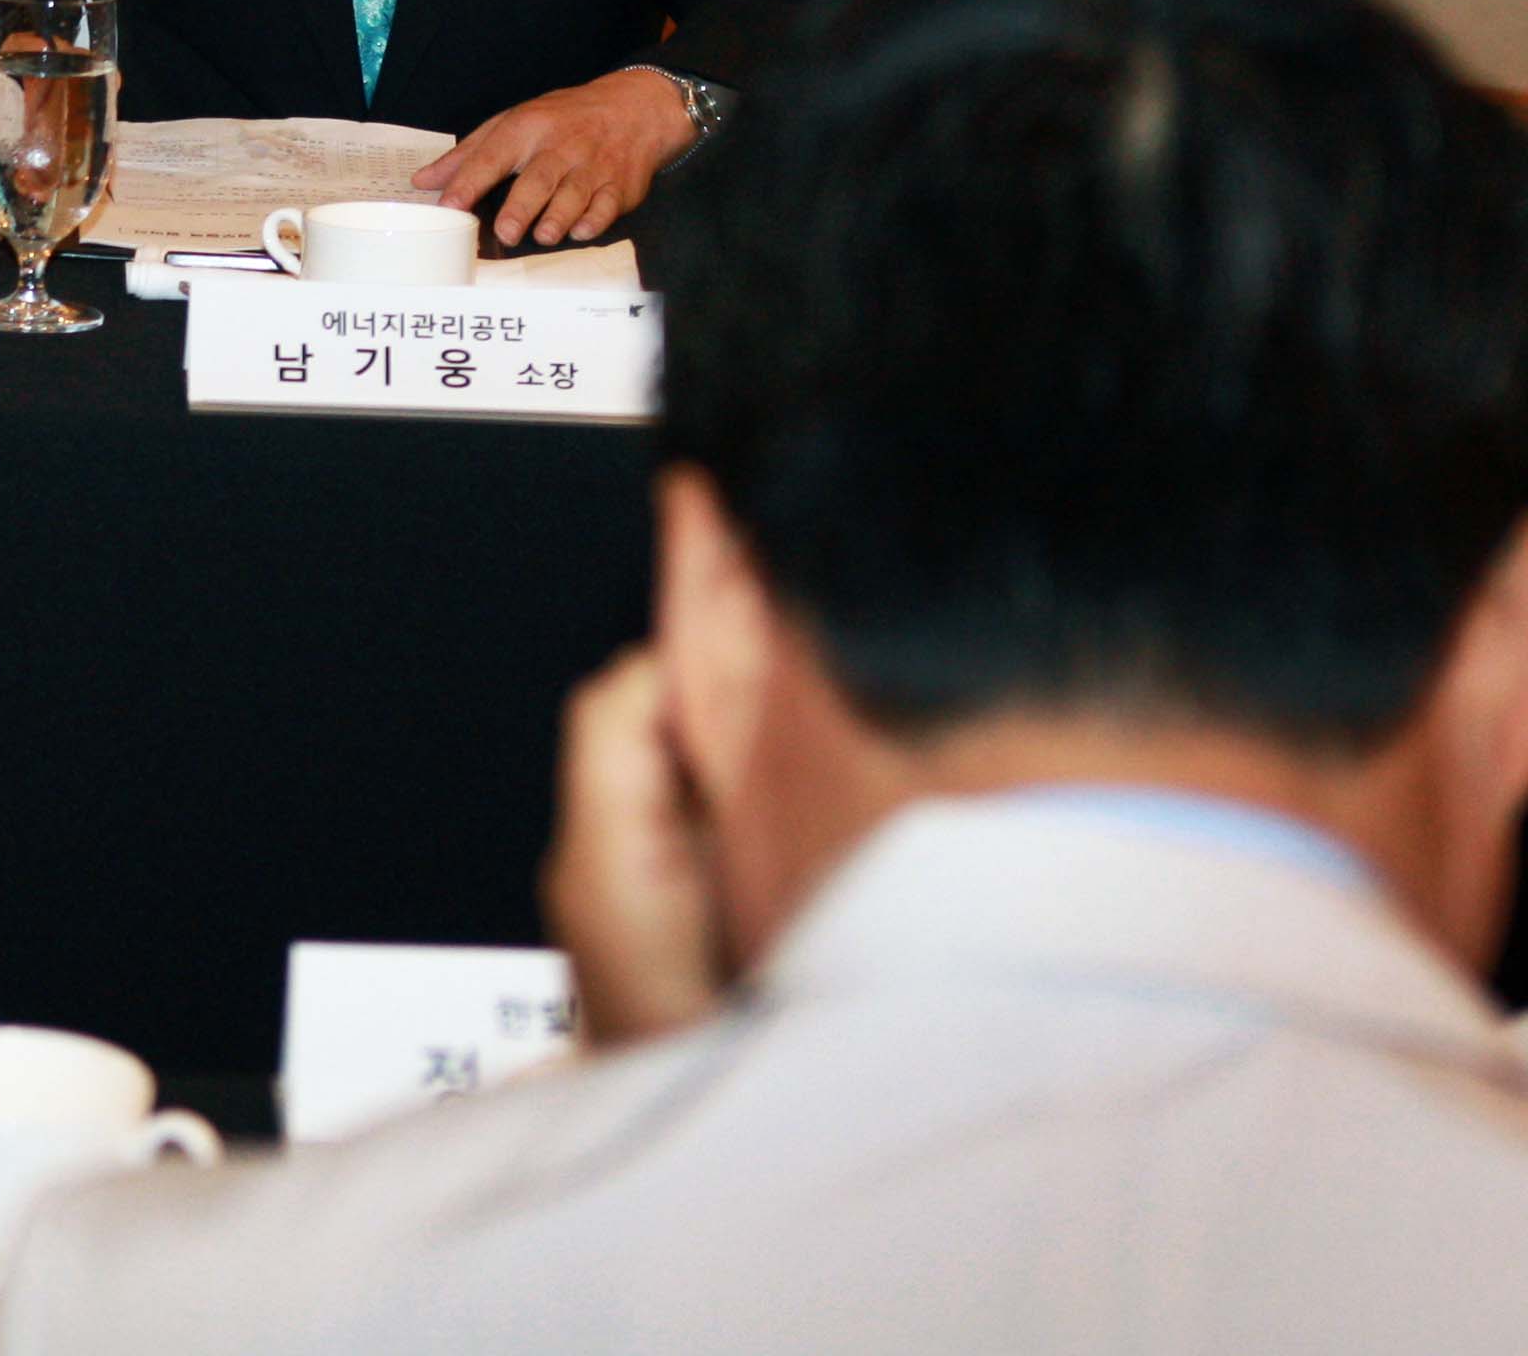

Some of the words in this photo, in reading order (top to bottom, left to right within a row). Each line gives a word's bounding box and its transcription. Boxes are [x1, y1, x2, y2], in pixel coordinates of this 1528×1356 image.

[321, 309, 527, 343] 에너지관리공단
[274, 343, 315, 384] 남
[354, 345, 392, 387] 기
[435, 348, 478, 389] 웅
[516, 361, 580, 391] 소장
